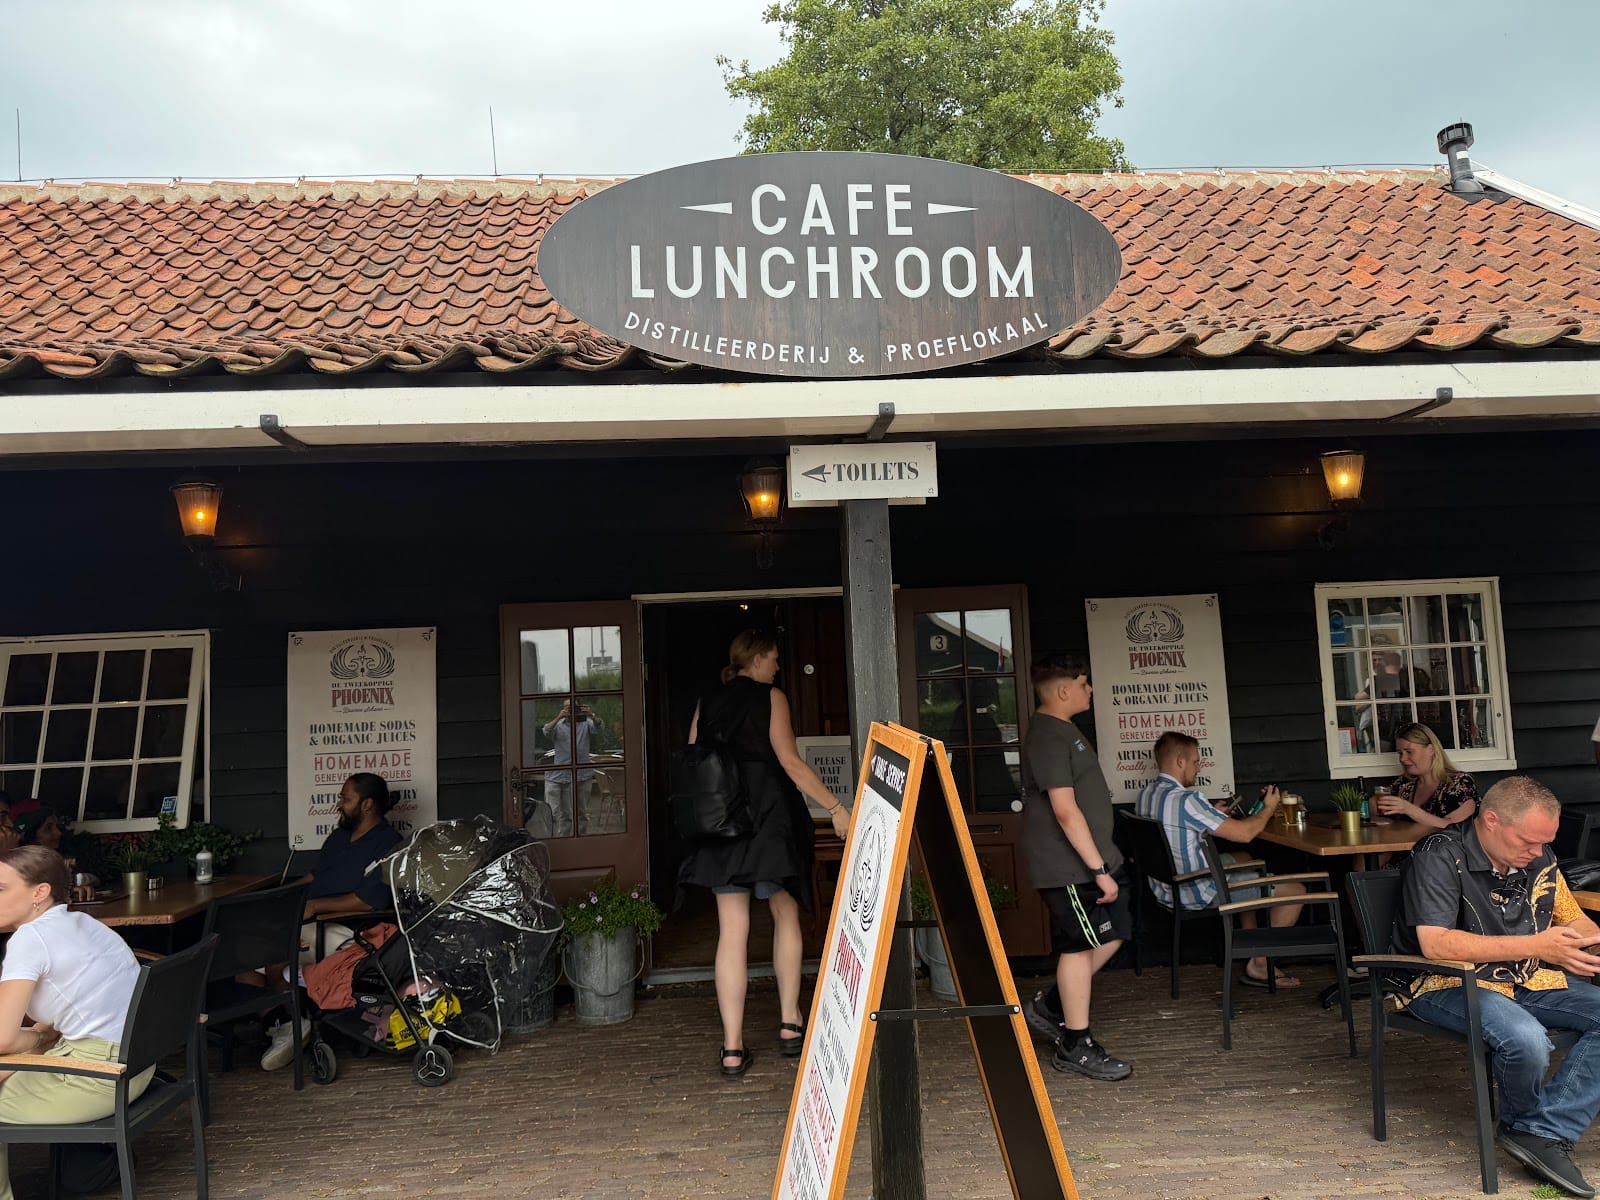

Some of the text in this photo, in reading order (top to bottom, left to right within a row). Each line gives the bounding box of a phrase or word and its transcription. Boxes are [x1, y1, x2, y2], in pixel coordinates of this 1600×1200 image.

[751, 183, 913, 236] CAFE
[630, 244, 1034, 299] LUNCHROOM
[624, 311, 1049, 364] DISTILLEERDERIJ & PROEFLOKAAL
[833, 462, 918, 482] TOILETS
[1129, 651, 1187, 670] PHOENIX
[1112, 682, 1207, 695] HOMEMADE SODAS
[331, 687, 395, 708] PHOENIX
[1112, 693, 1209, 706] & ORGANIC JUICES
[309, 719, 416, 735] HOMEMADE SODAS
[1118, 712, 1206, 729] HOMEMADE
[308, 731, 416, 746] & ORGANIC JUICES
[1120, 730, 1161, 741] GENEVERS
[314, 752, 411, 770] HOMEMADE
[814, 756, 846, 765] PLEASE
[819, 766, 842, 775] WAIT
[822, 776, 839, 784] FOR
[833, 927, 864, 1022] PHOENIX
